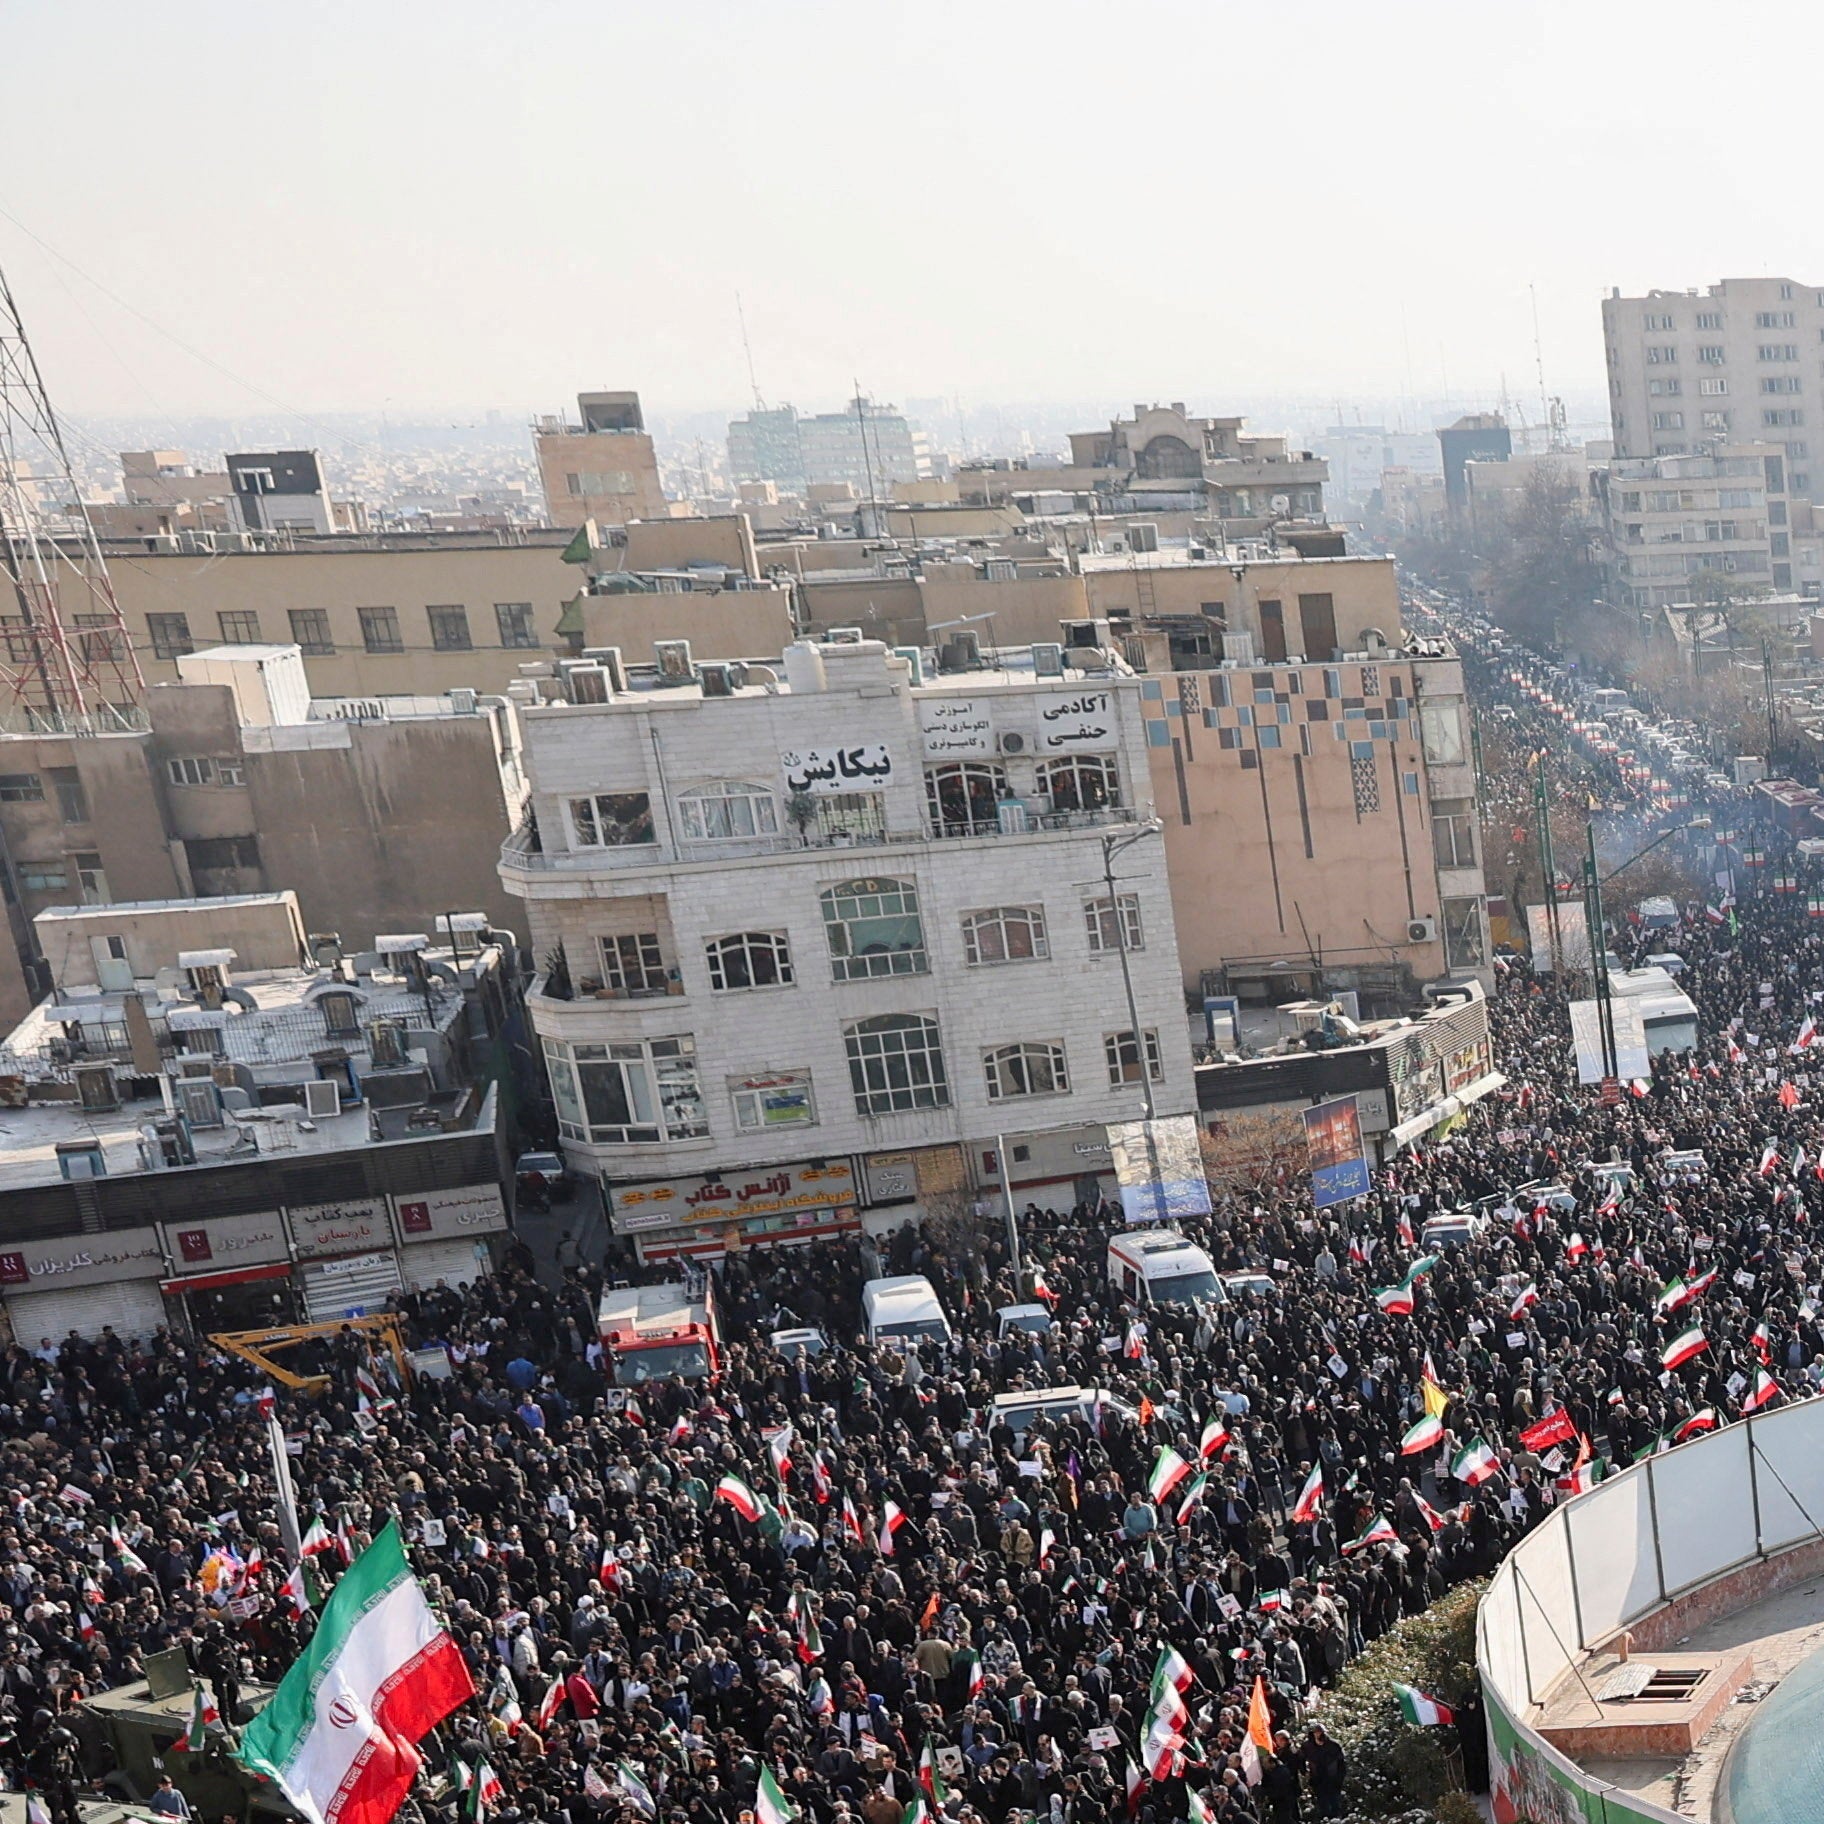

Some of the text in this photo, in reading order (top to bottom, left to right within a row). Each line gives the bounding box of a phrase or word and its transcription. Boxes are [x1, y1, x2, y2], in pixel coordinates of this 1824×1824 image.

[934, 703, 972, 717] آموزش
[1043, 693, 1108, 720] آکادمی
[928, 736, 976, 751] کامپیوتری
[1047, 724, 1107, 746] حنفی
[787, 745, 891, 791] نیکایش
[685, 1181, 732, 1207] کتاب
[736, 1173, 791, 1201] آژانس
[305, 1209, 343, 1225] کتاب
[680, 1189, 854, 1222] فروشگاه اینترنتی کتاب
